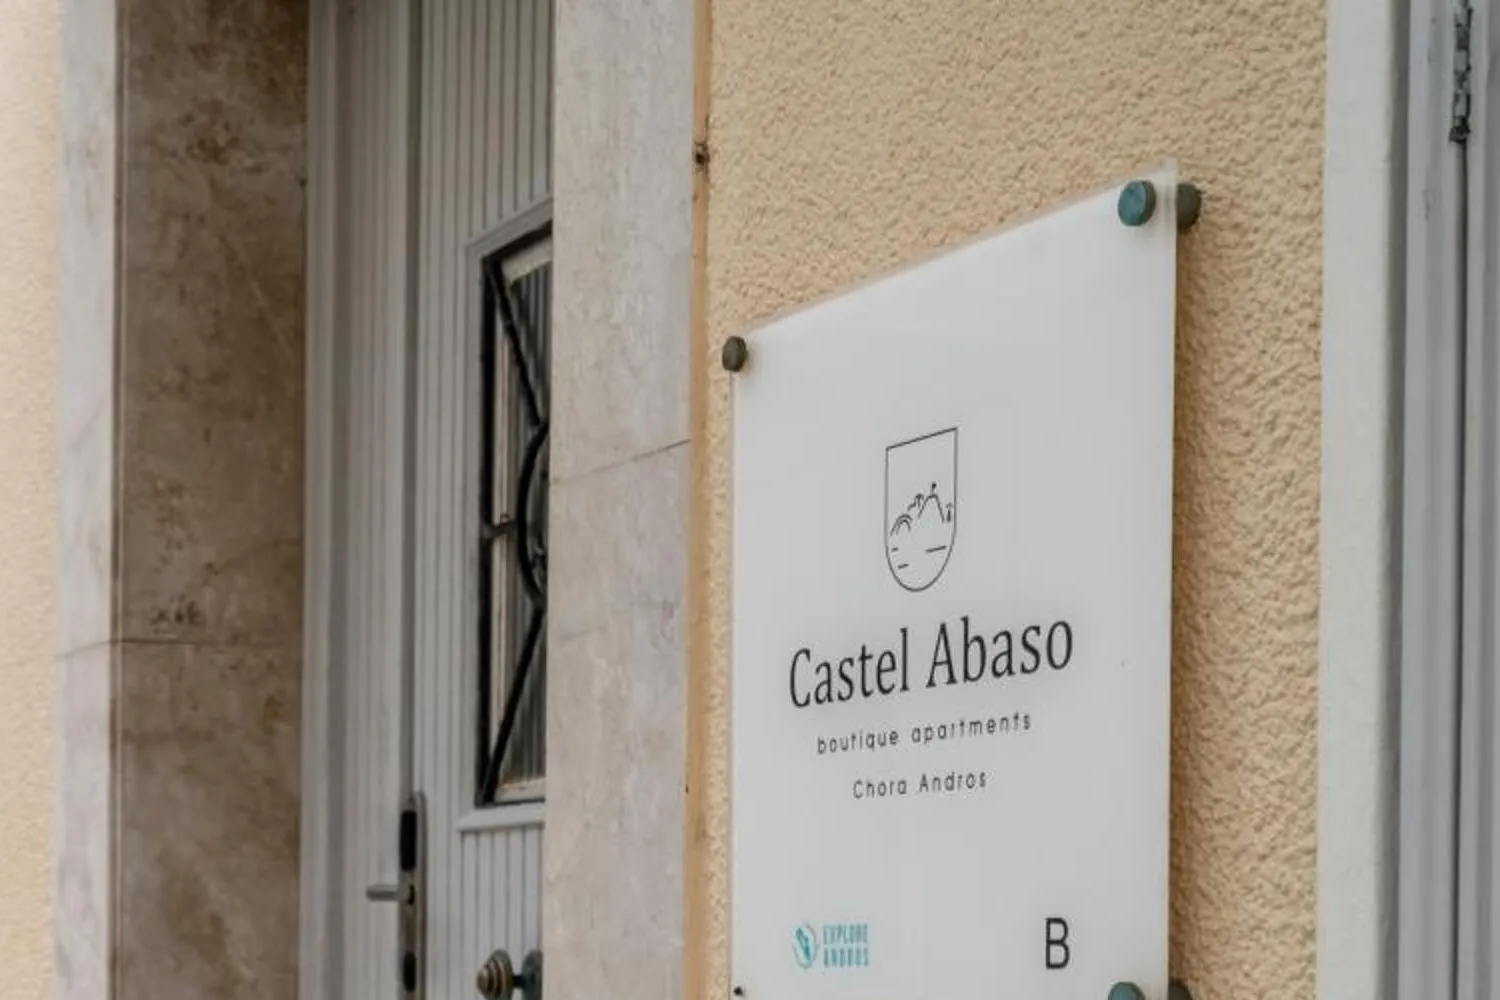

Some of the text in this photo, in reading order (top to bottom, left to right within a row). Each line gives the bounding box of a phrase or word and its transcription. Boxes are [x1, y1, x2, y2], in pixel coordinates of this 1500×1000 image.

[789, 614, 1074, 709] Castel Abaso
[817, 710, 1032, 756] boutique apartments
[852, 769, 987, 800] Chora Andros
[1044, 916, 1071, 970] B
